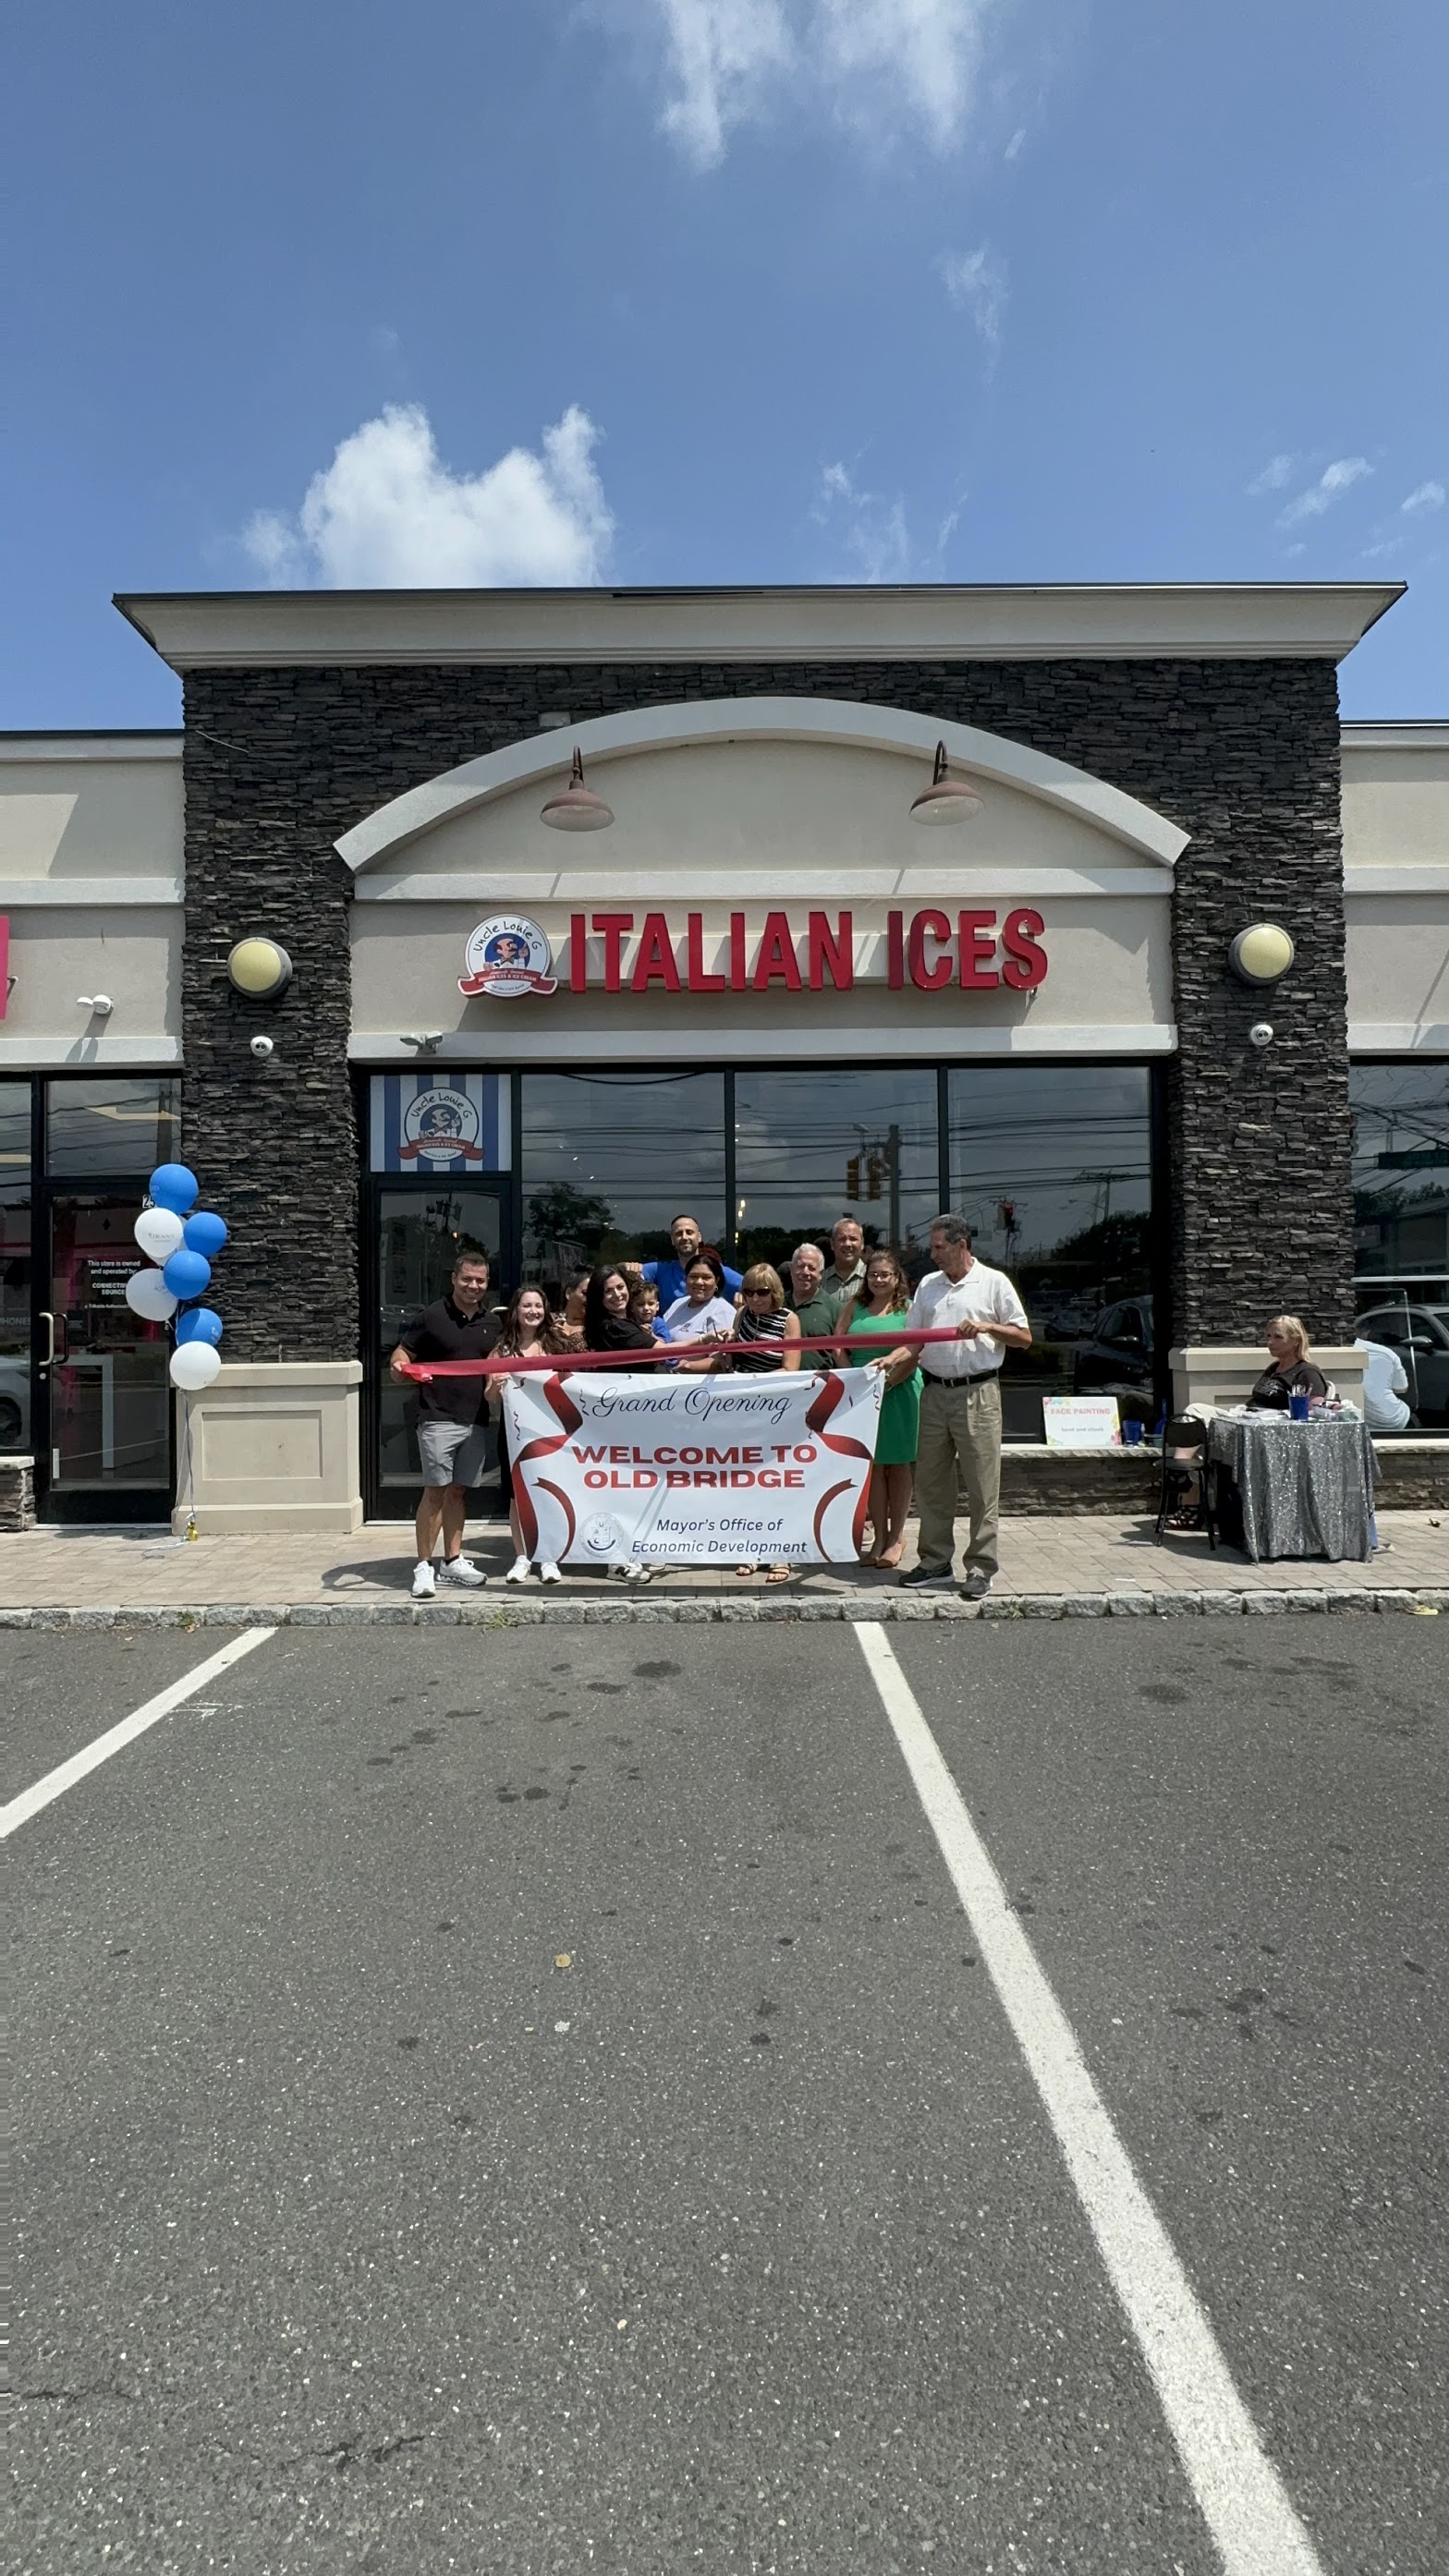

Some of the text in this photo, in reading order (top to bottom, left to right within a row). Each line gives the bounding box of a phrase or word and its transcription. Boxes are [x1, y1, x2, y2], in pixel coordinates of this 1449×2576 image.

[473, 921, 542, 951] Uncle Louie G
[570, 908, 1048, 992] ITALIAN ICES
[411, 1092, 472, 1119] Uncle Louie G
[591, 1386, 792, 1424] Grand Opening
[572, 1444, 818, 1464] WELCOME TO
[583, 1469, 805, 1489] OLD BRIDGE
[656, 1517, 784, 1536] Mayor's Office of
[631, 1538, 808, 1556] Economic Development
